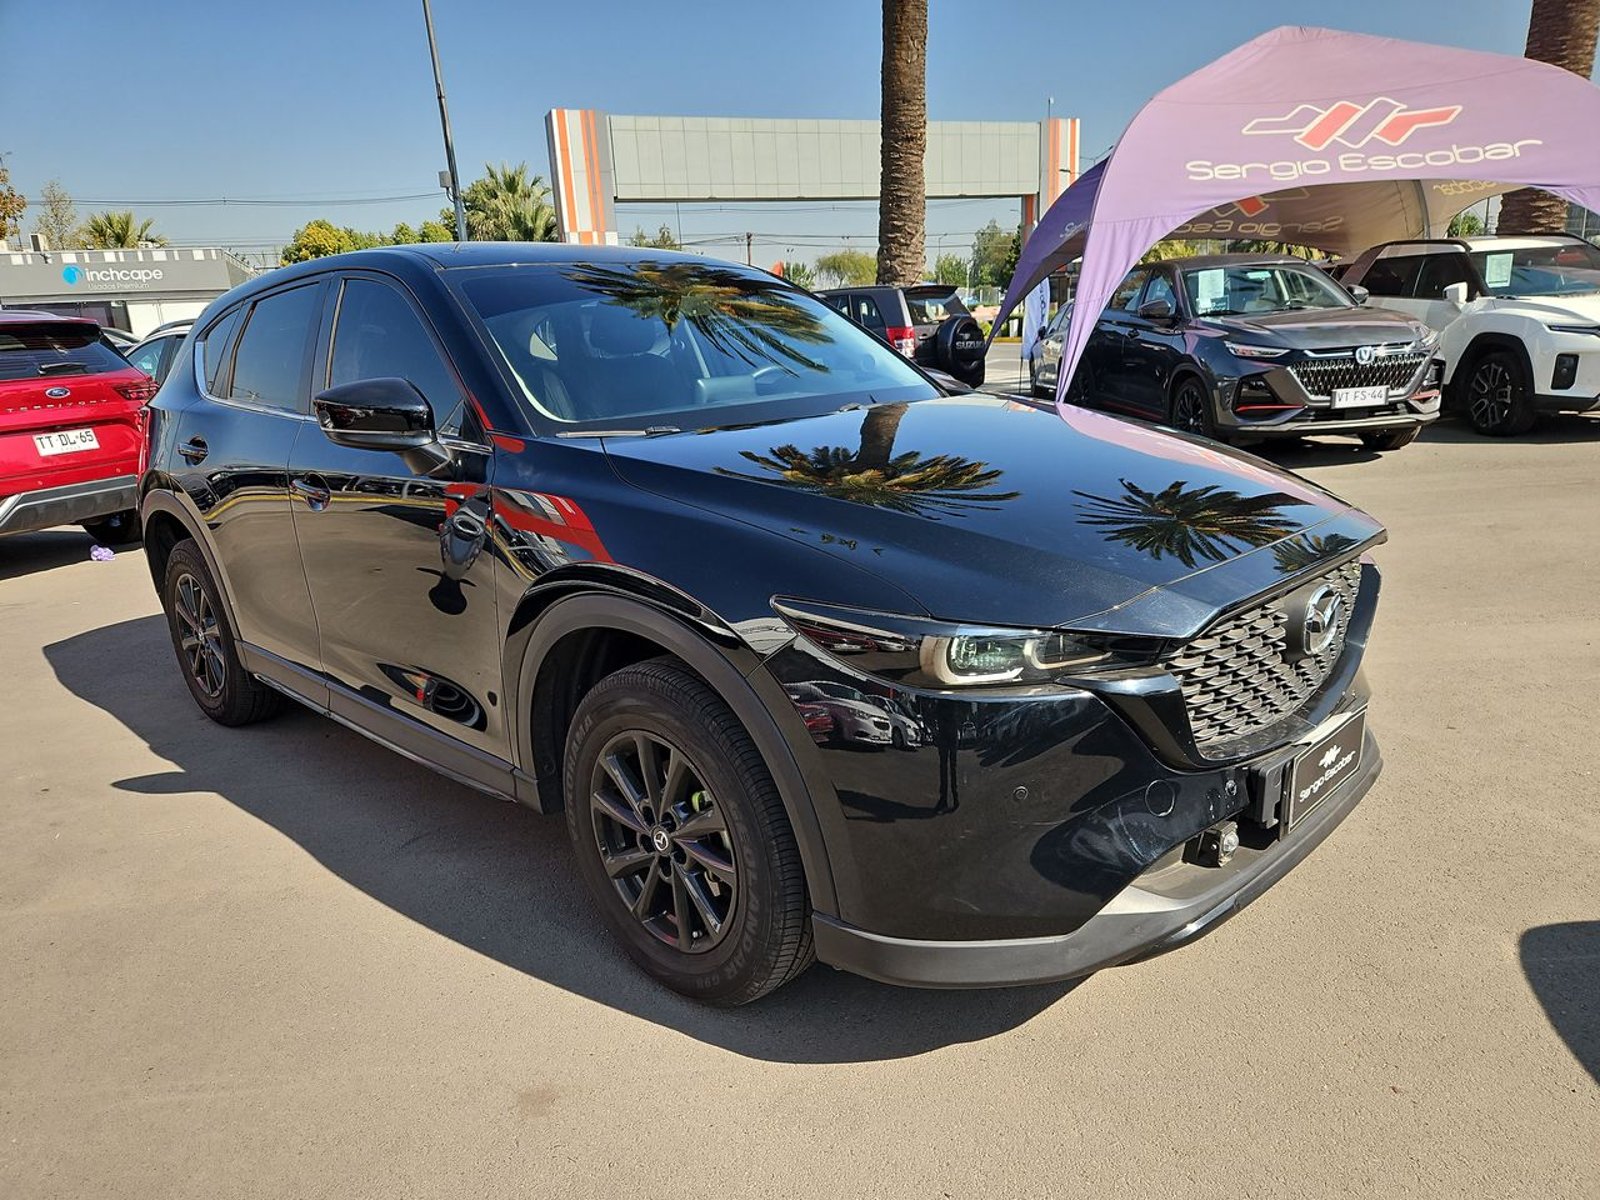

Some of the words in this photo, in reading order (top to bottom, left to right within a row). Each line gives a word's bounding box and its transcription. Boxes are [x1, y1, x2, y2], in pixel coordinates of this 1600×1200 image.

[1185, 158, 1331, 181] Sergio
[1338, 139, 1543, 172] Escobar
[85, 267, 164, 283] inchcape
